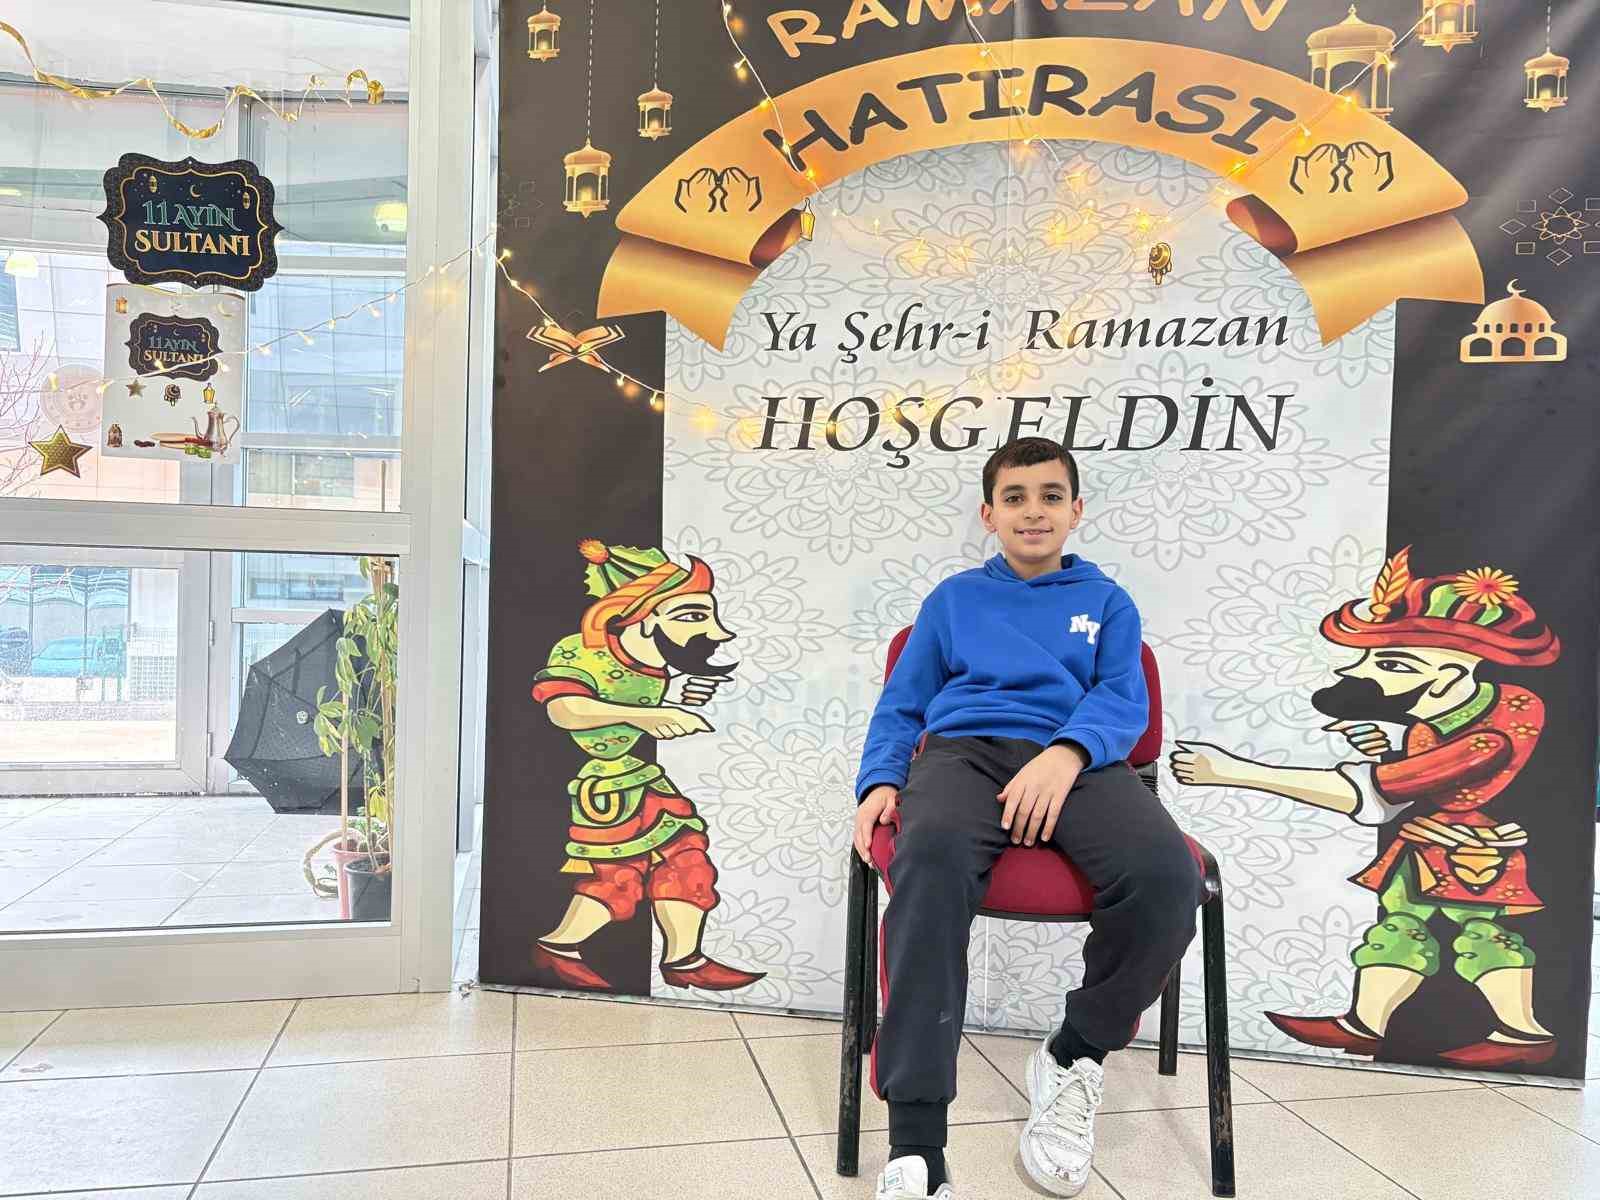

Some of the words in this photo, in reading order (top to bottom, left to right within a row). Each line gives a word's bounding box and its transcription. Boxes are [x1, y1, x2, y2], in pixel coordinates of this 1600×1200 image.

[763, 65, 1297, 173] HATIRASI
[134, 229, 251, 256] SULTANI
[142, 200, 171, 226] 11
[173, 202, 243, 232] AYIN
[759, 311, 817, 352] Ya
[837, 302, 991, 364] Şehr-i
[1024, 309, 1290, 351] Ramazan
[752, 376, 1296, 470] HOŞGELDİN
